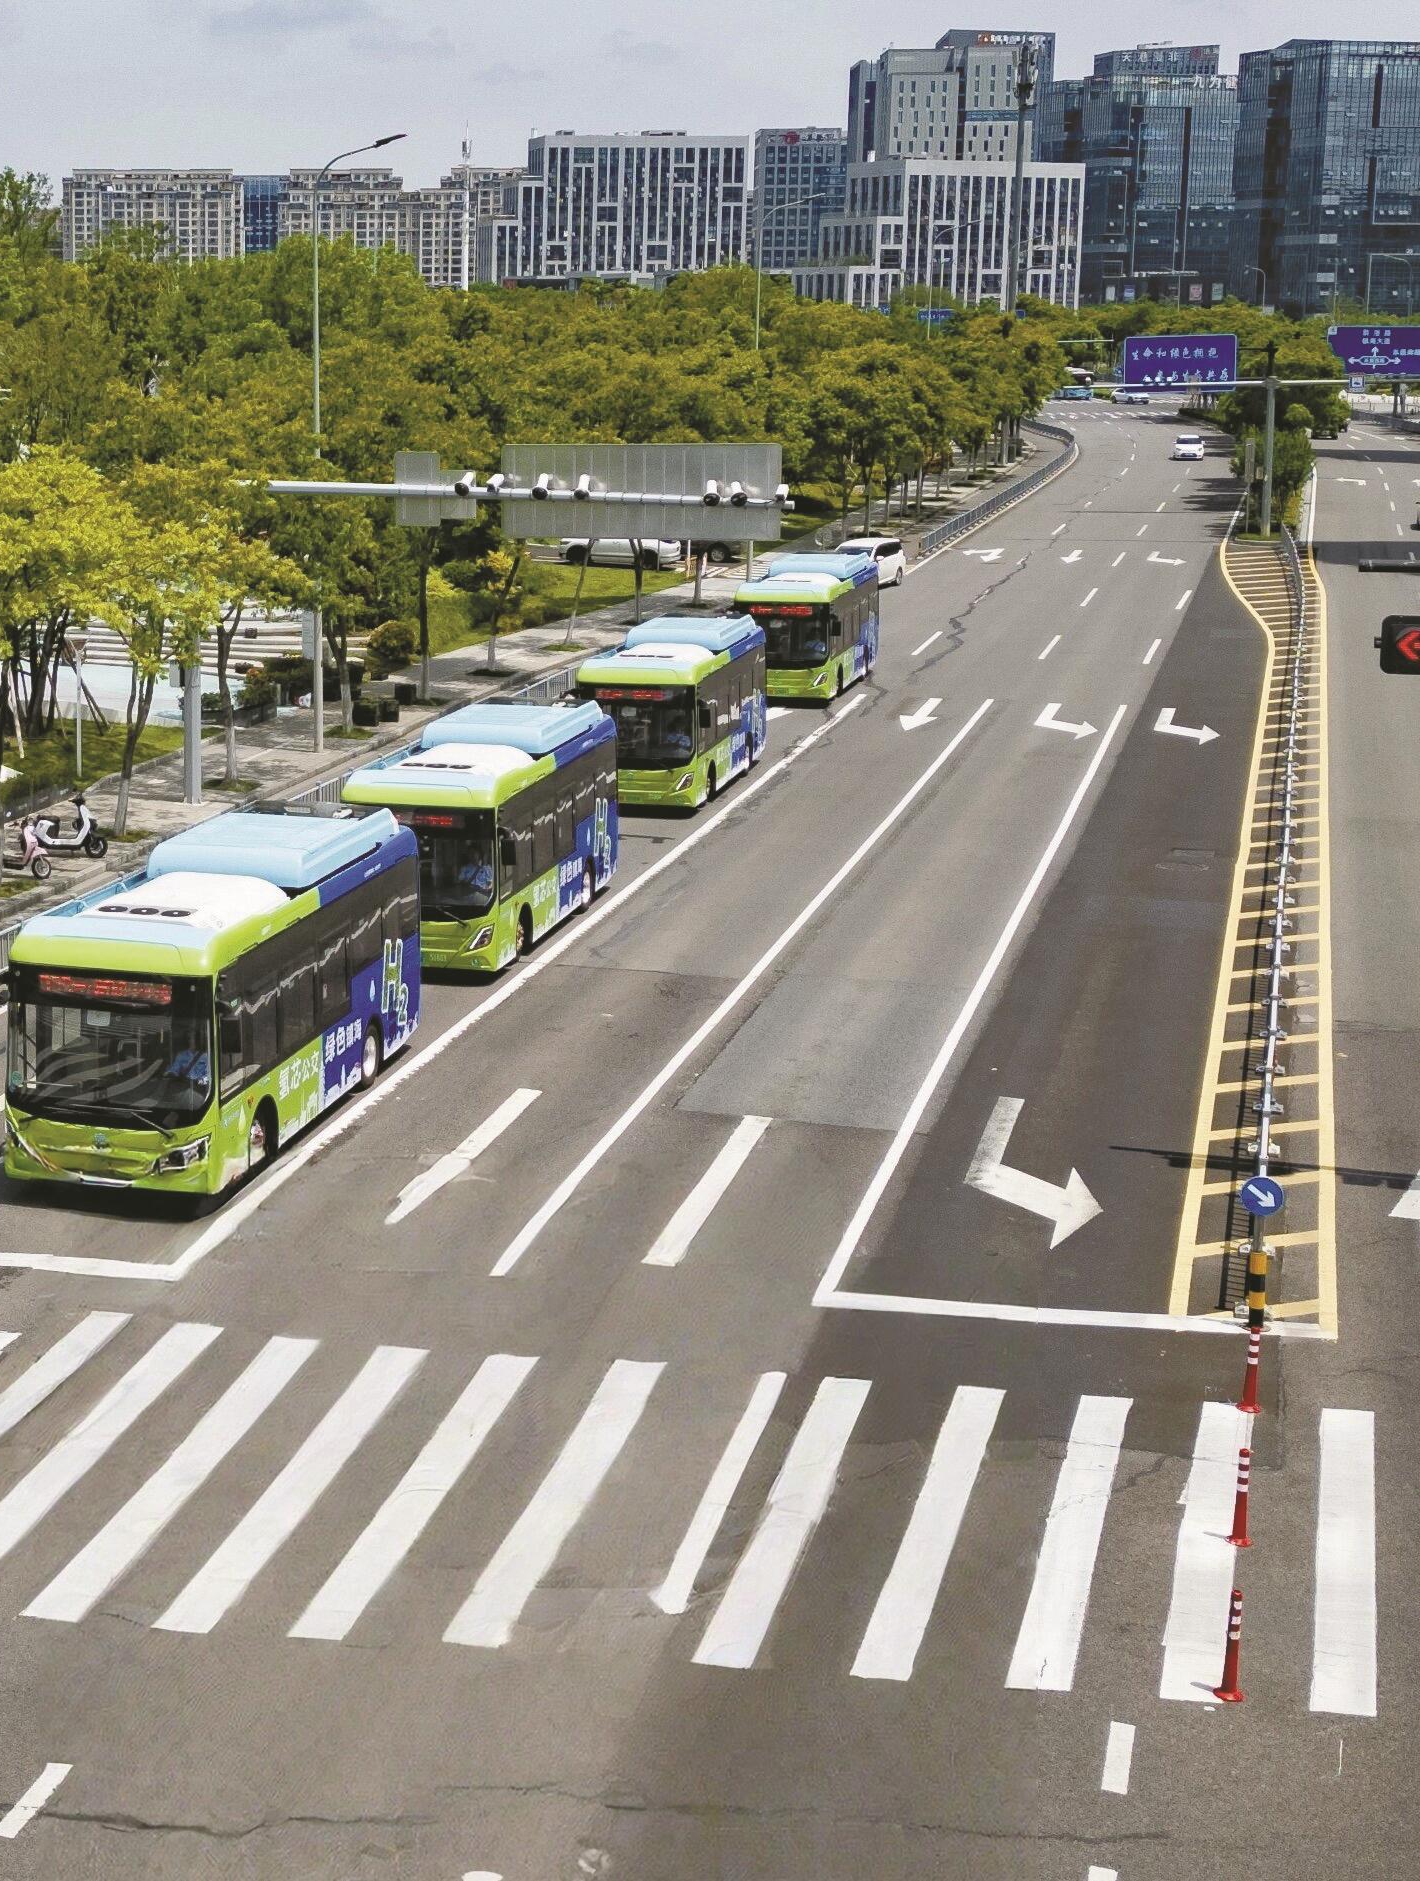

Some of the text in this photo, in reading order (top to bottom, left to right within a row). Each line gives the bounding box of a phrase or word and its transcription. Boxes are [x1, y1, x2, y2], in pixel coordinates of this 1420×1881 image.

[1131, 346, 1219, 361] 生命和绿色拥抱
